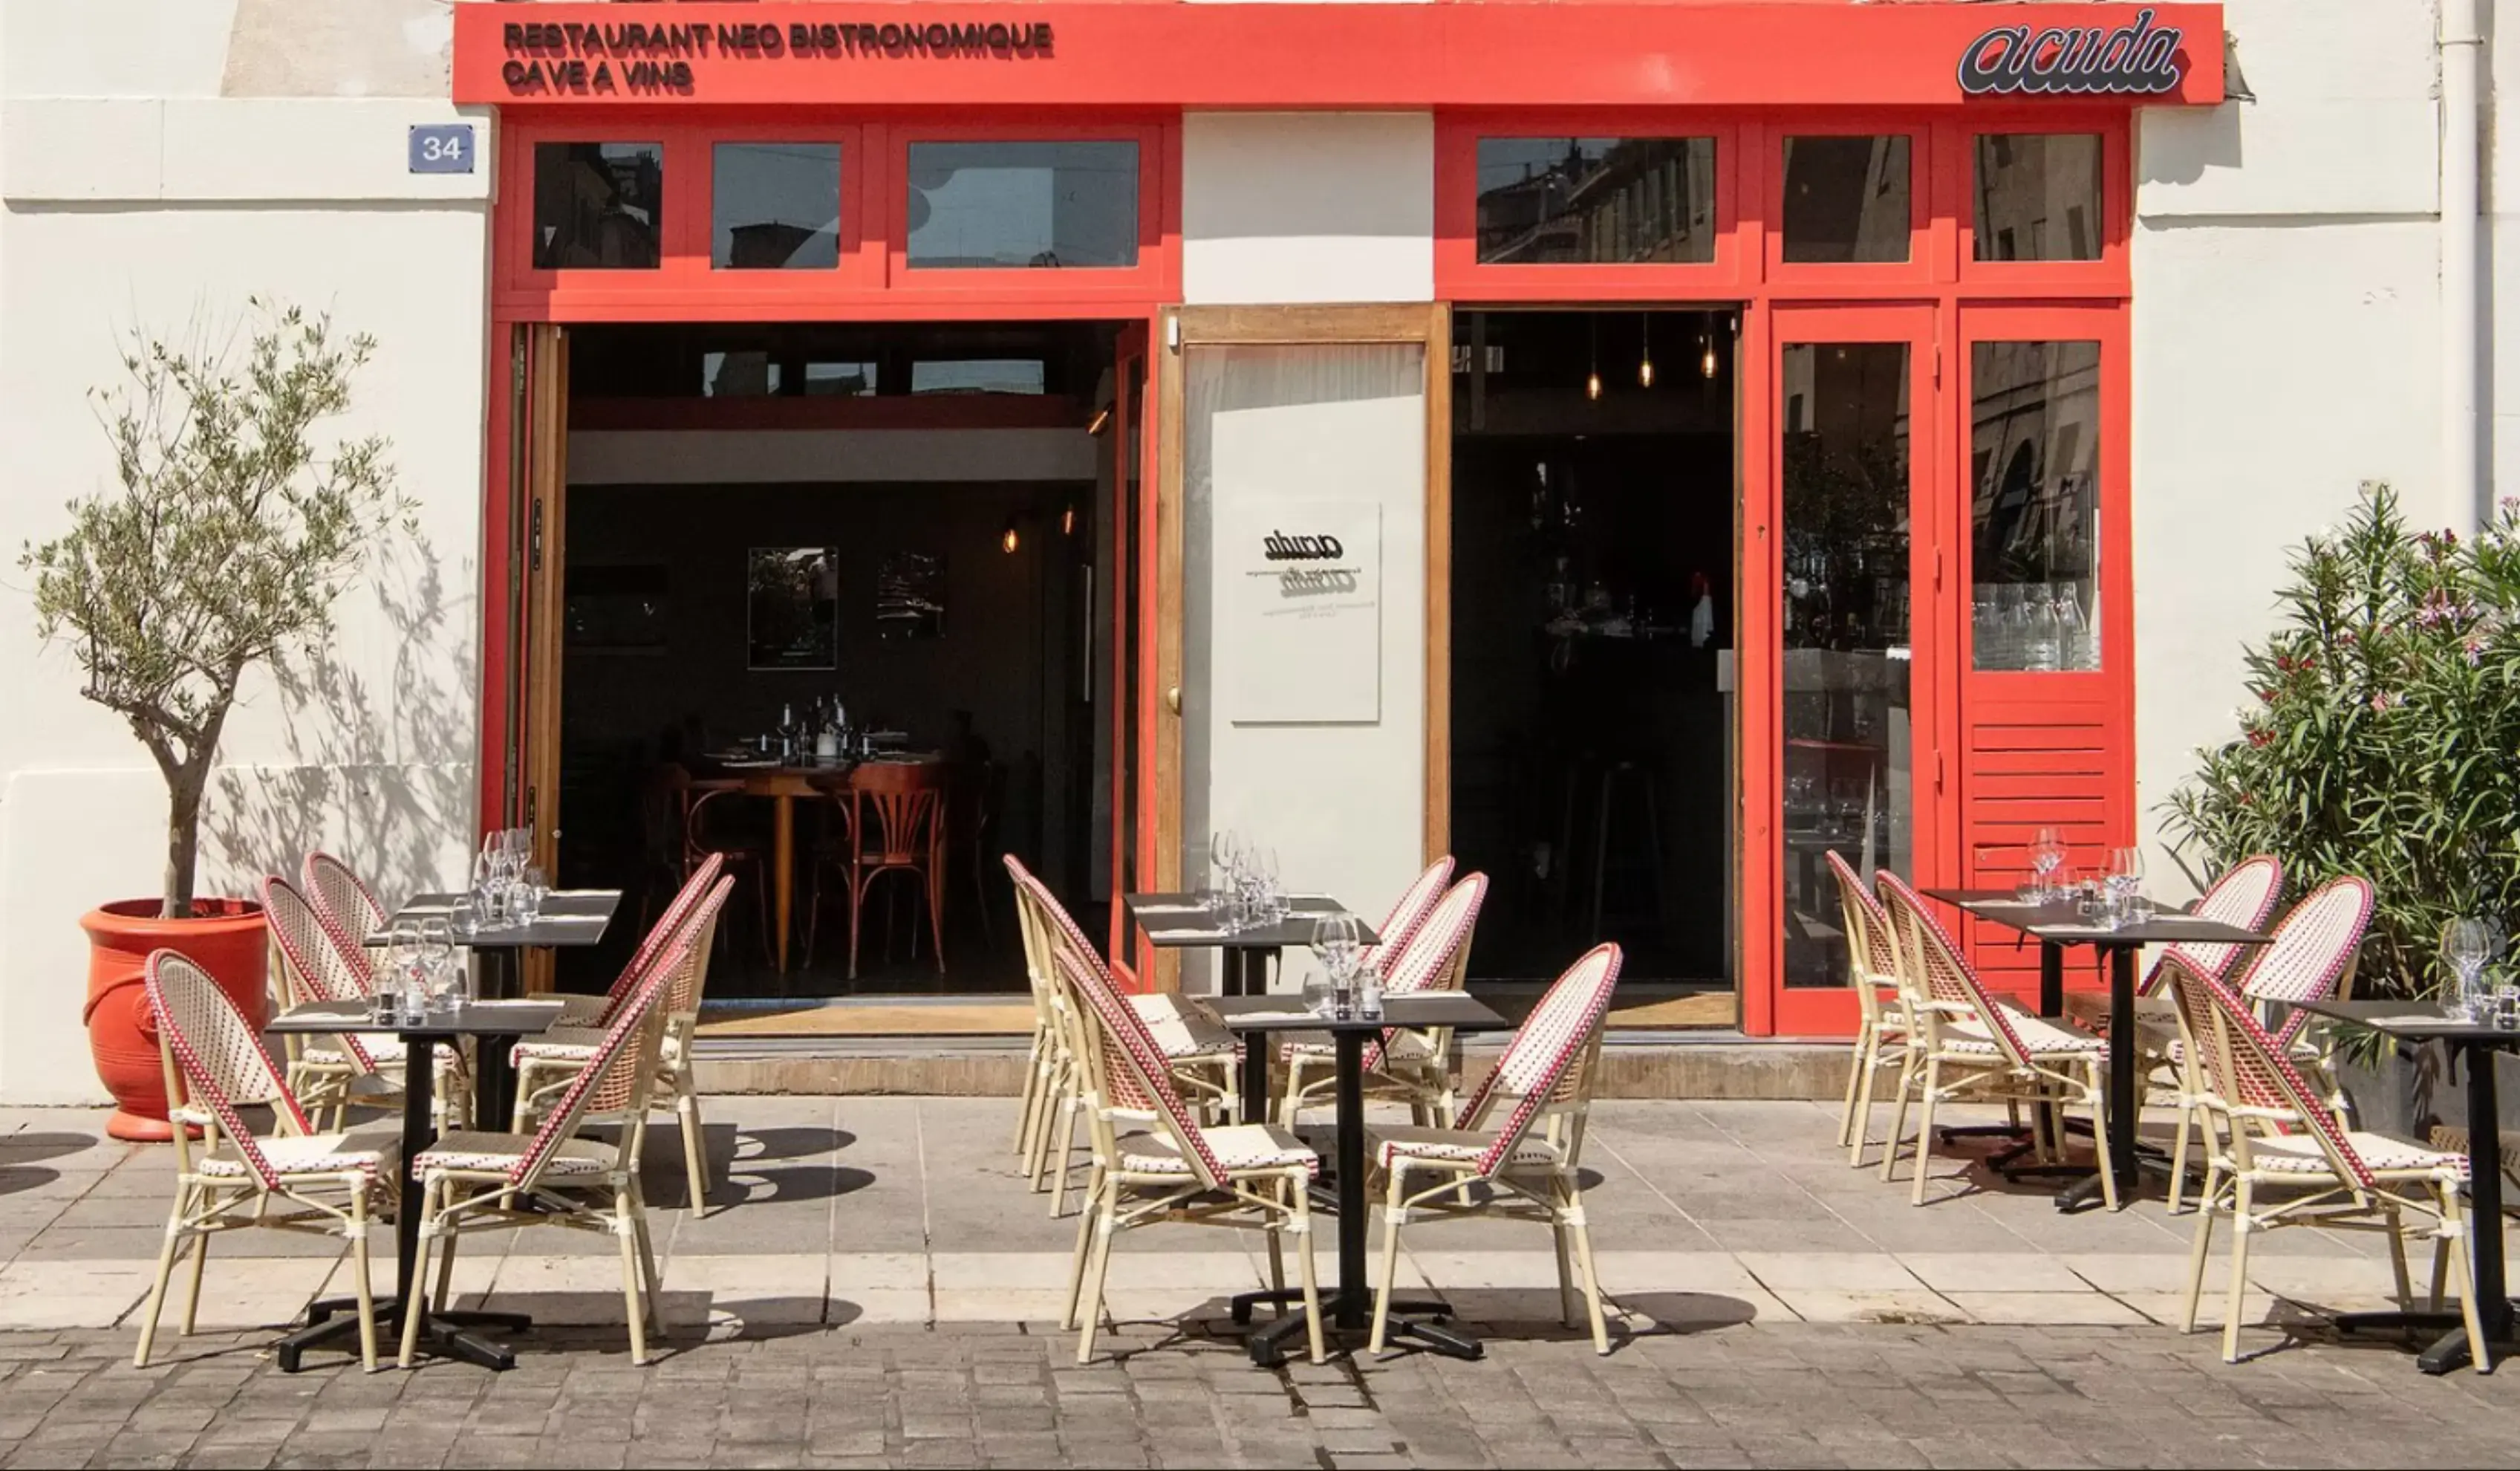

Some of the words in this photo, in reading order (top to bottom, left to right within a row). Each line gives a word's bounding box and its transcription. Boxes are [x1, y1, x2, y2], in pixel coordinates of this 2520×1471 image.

[503, 22, 711, 50] RESTAURANT
[717, 23, 781, 50] NEO
[789, 22, 1052, 51] BISTRONOMIQUE
[1957, 8, 2183, 94] acuda
[501, 59, 589, 87] CAVE
[620, 60, 693, 87] VINS
[423, 135, 462, 161] 34
